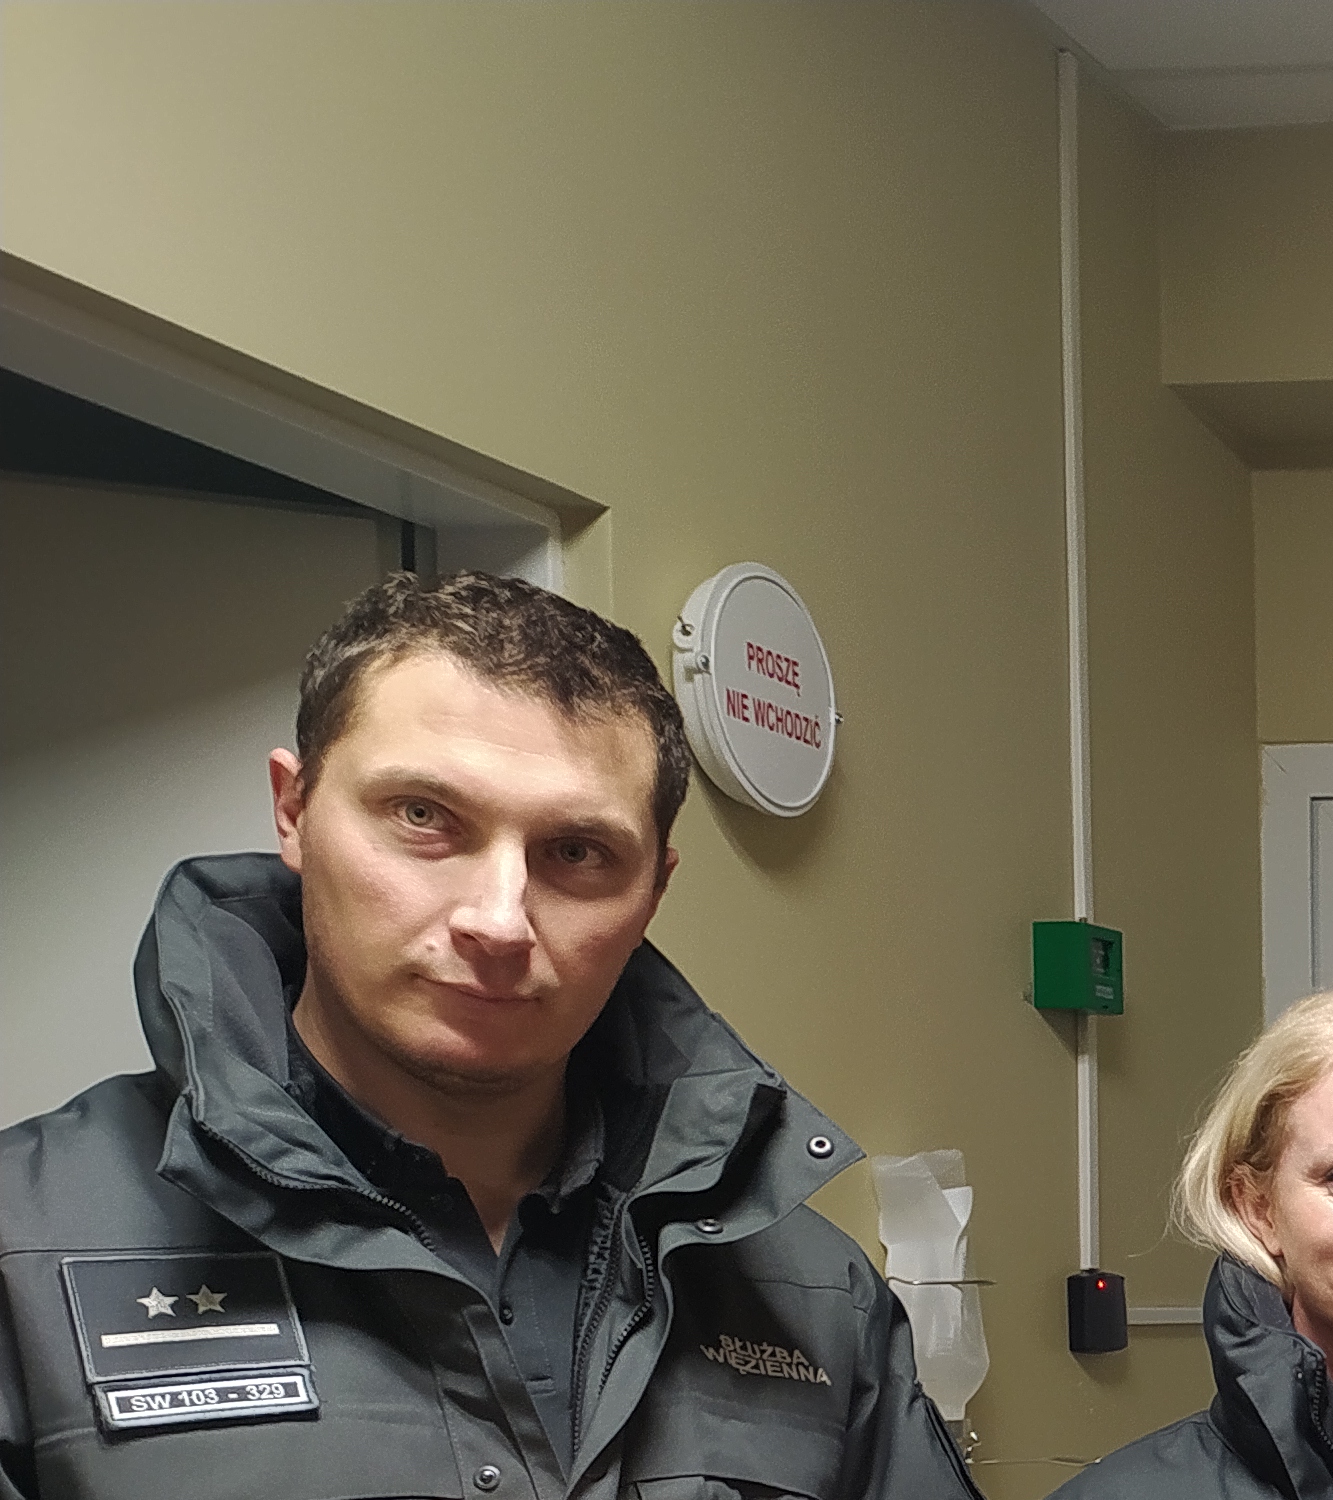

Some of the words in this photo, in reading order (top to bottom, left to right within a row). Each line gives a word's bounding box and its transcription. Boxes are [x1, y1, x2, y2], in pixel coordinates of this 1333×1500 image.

[746, 642, 801, 697] PROSZĘ
[726, 688, 750, 723] NIE
[752, 697, 822, 749] WCHODZIĆ
[700, 1345, 832, 1386] WIĘZIENNA
[719, 1334, 809, 1365] SŁUŻBA
[130, 1394, 171, 1411] SW
[178, 1389, 219, 1406] 103
[245, 1383, 285, 1400] 329
